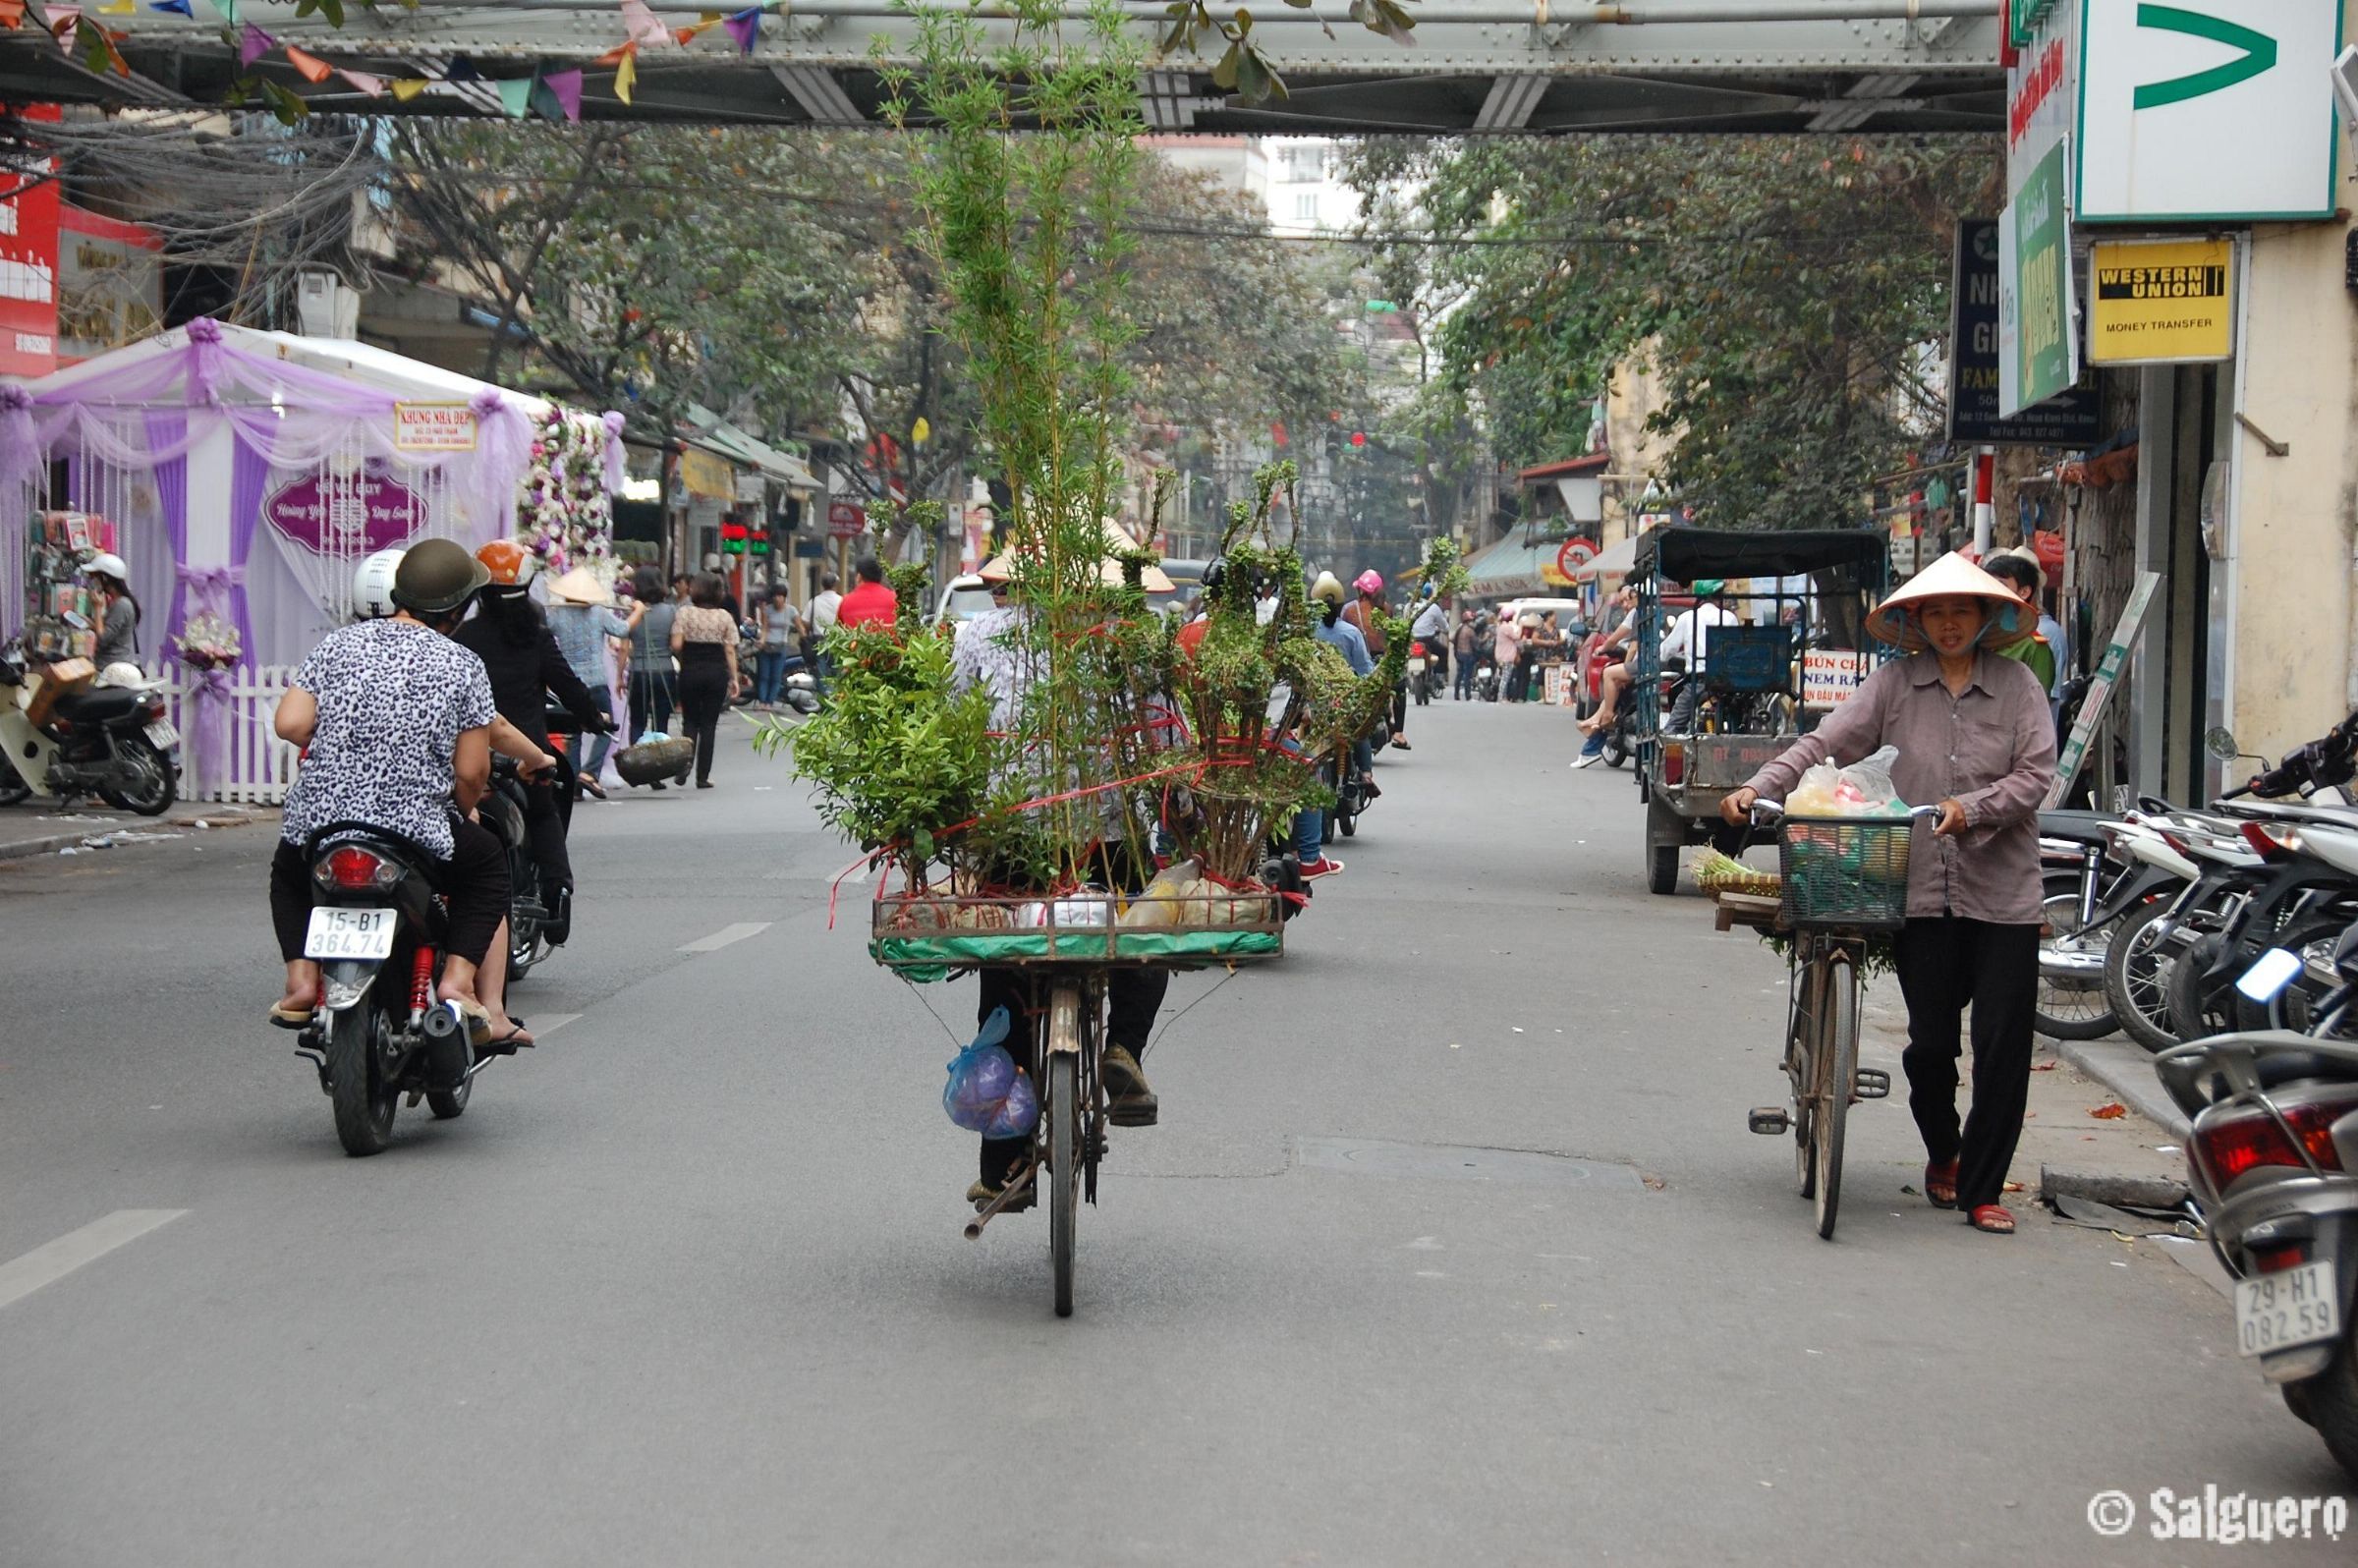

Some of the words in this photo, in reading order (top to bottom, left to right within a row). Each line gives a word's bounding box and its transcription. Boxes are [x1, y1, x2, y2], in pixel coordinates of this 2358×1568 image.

[2101, 266, 2202, 284] WESTERN
[2132, 282, 2202, 298] UNION
[2106, 322, 2147, 332] MONEY
[2152, 318, 2212, 329] TRANSFER
[400, 409, 430, 424] KHUNG
[1804, 655, 1835, 669] BÚN
[326, 911, 382, 932] 15-B1
[310, 933, 386, 955] 364.74
[2248, 1267, 2319, 1315] 29-H1
